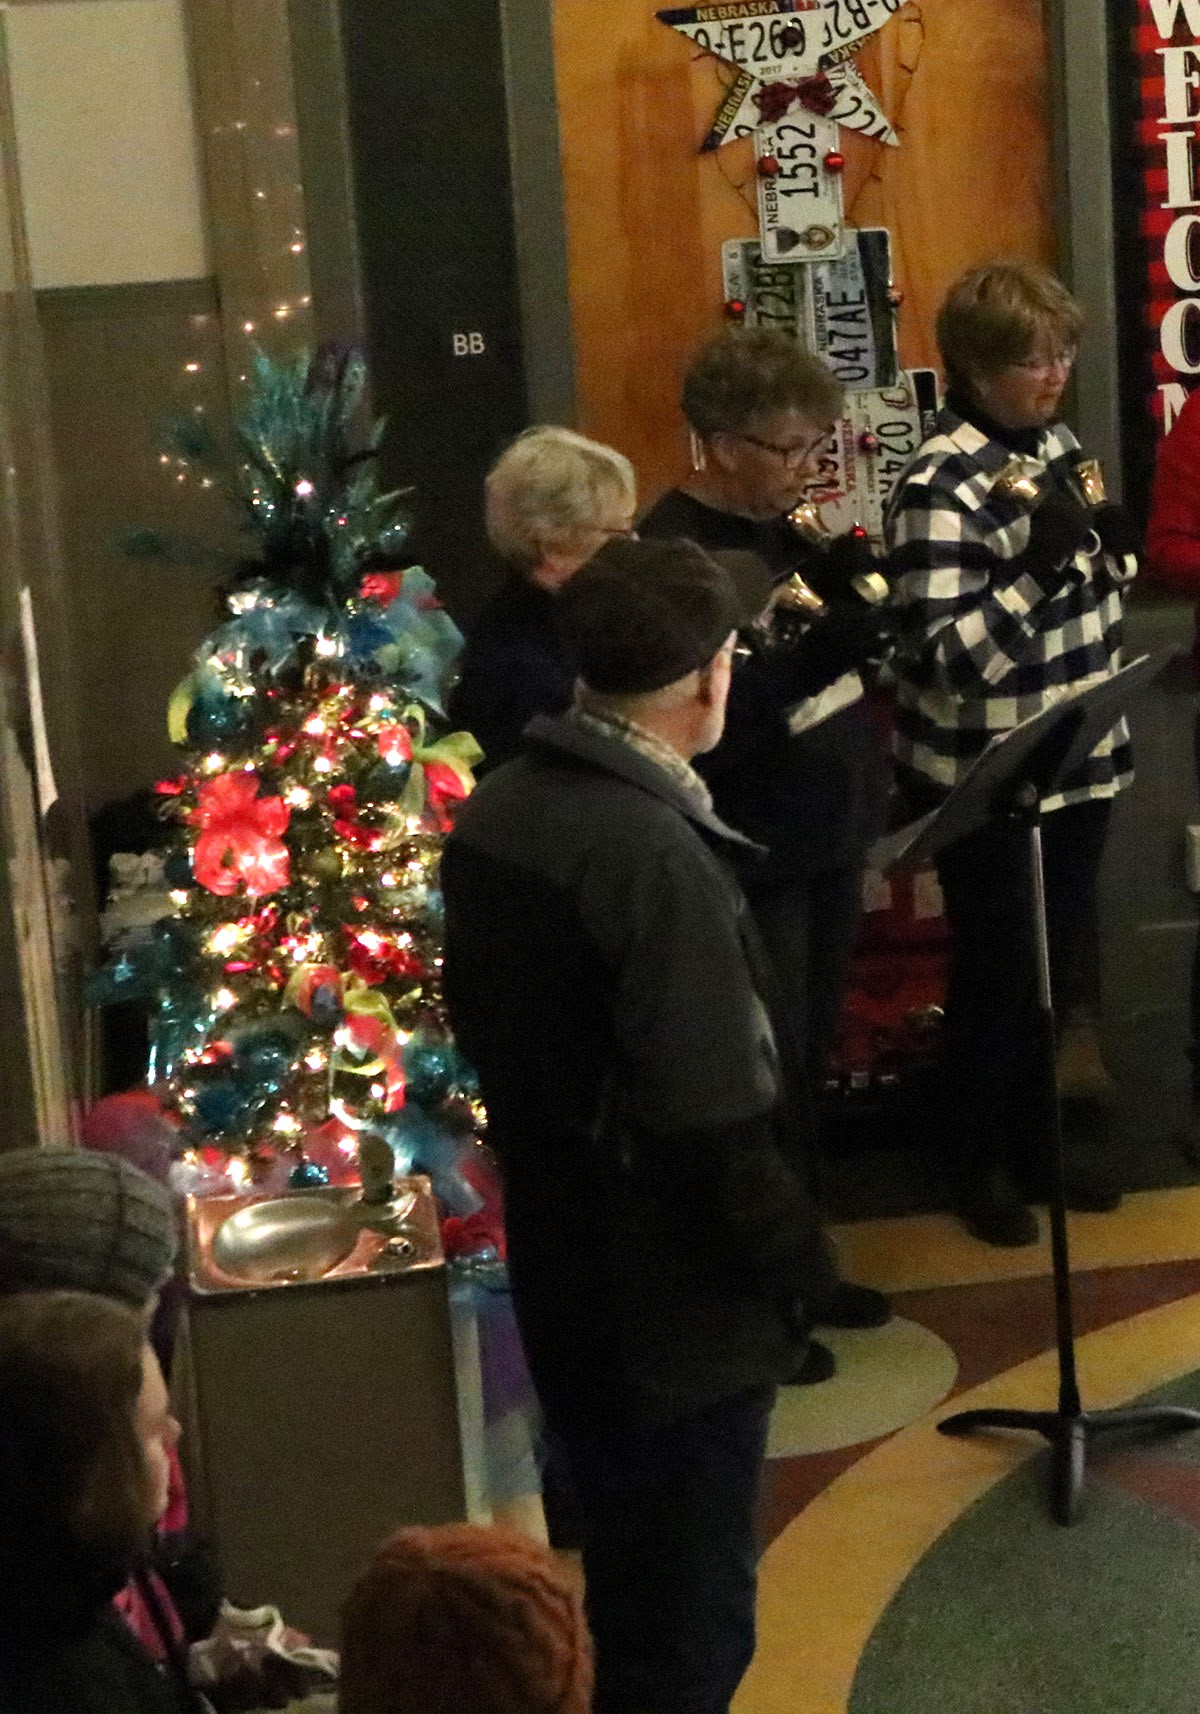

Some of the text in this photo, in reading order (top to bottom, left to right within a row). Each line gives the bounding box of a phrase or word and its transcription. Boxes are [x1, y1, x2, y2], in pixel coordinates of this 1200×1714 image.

[695, 1, 780, 21] NEBRASKA
[759, 64, 783, 75] 2017
[776, 122, 819, 199] 1552
[453, 332, 486, 356] BB
[828, 288, 869, 382] 047AE
